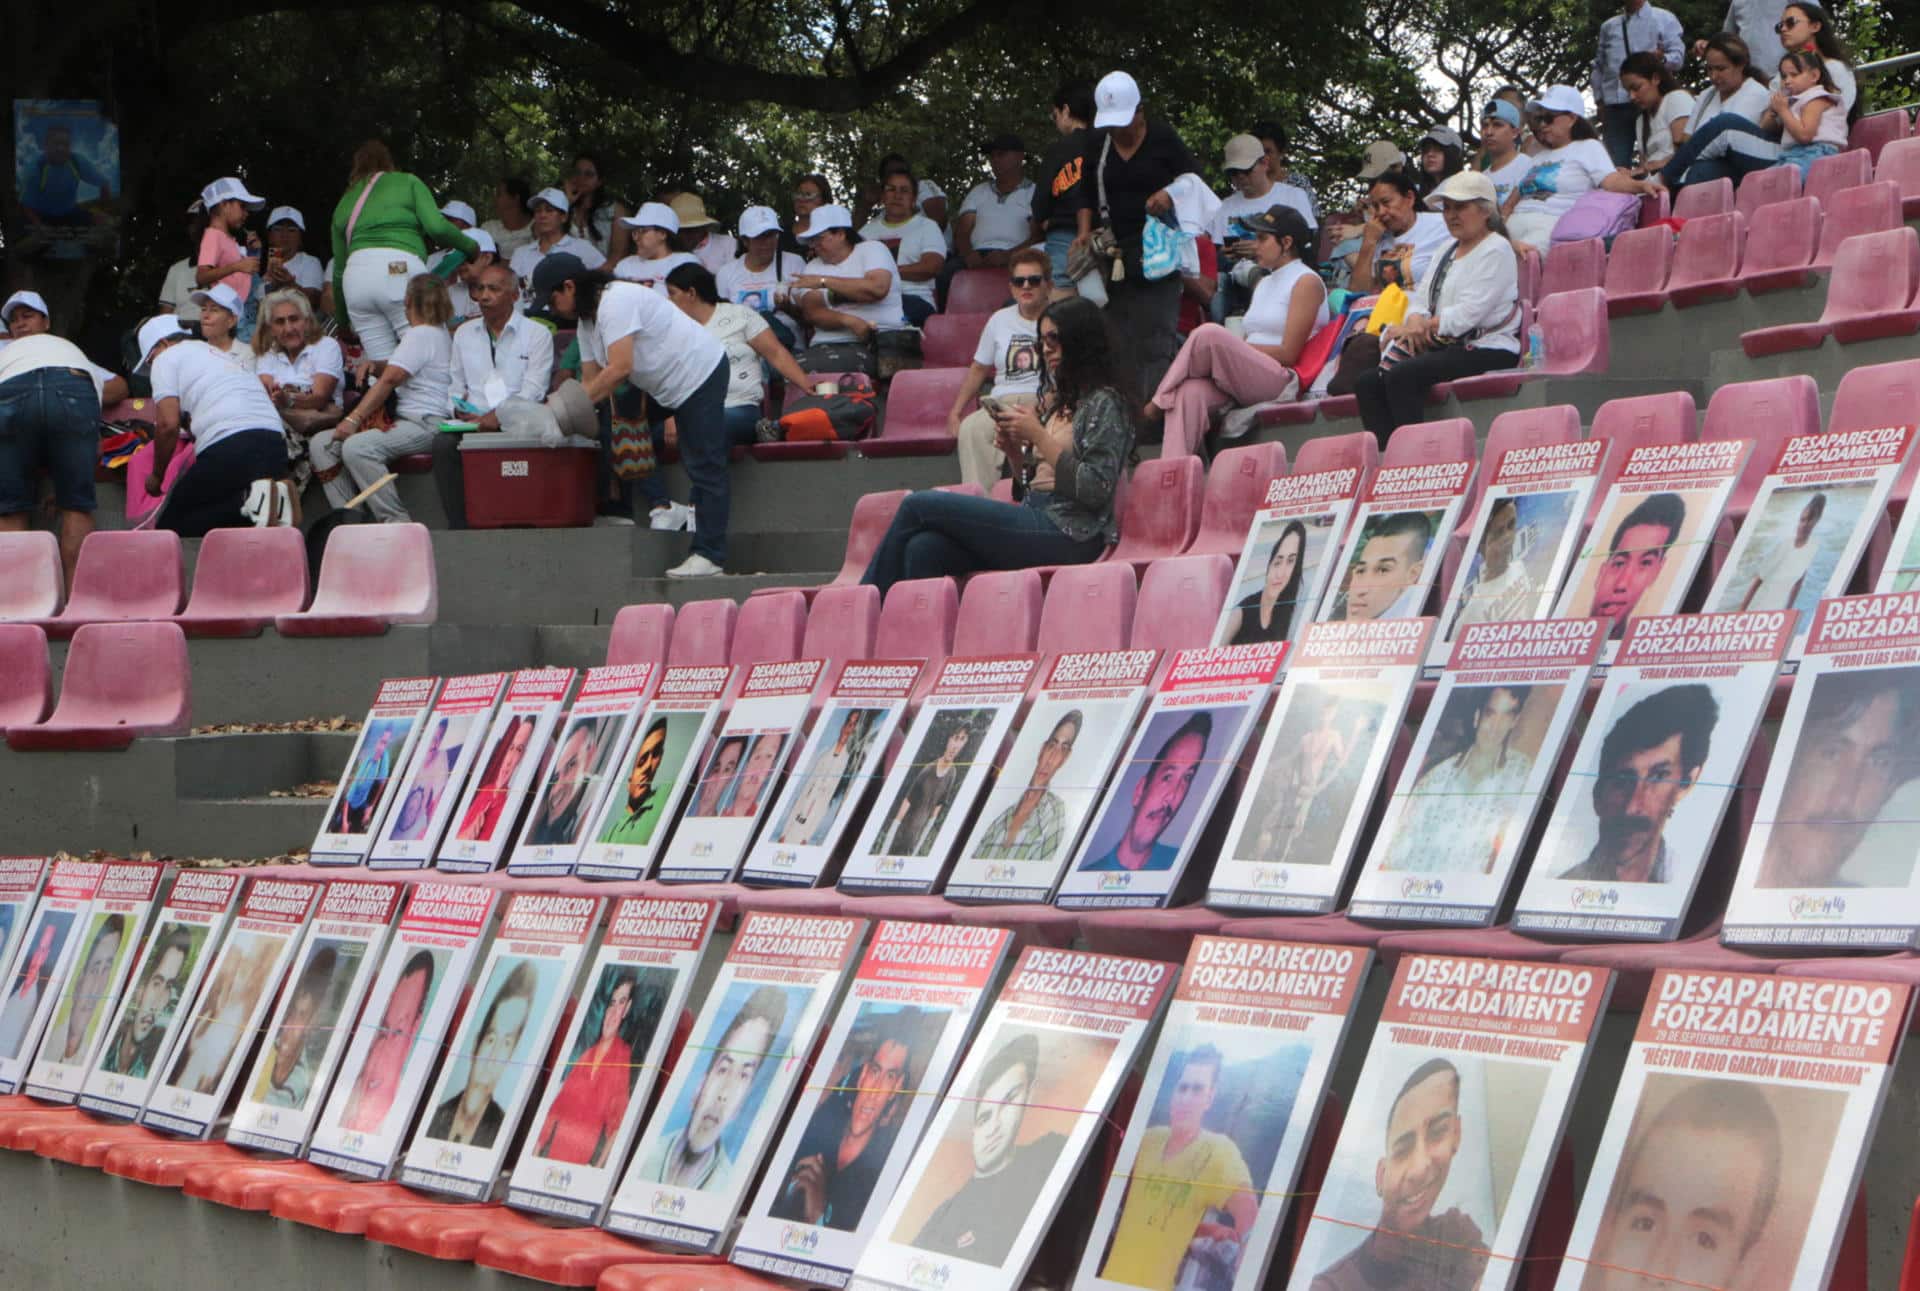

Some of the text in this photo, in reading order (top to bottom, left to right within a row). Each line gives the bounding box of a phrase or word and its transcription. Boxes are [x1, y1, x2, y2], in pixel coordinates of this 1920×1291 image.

[1786, 427, 1906, 452] DESAPARECIDA
[1503, 440, 1601, 463] DESAPARECIDO
[1631, 440, 1743, 461] DESAPARECIDO
[1779, 442, 1900, 466] FORZADAMENTE
[1378, 462, 1468, 481] DESAPARECIDO
[1499, 455, 1596, 477] FORZADAMENTE
[1624, 456, 1736, 475] FORZADAMENTE
[1270, 468, 1356, 491] DESAPARECIDO
[1372, 475, 1464, 495] FORZADAMENTE
[1265, 481, 1352, 503] FORZADAMENTE
[1309, 621, 1424, 641] DESAPARECIDO
[1465, 620, 1597, 643] DESAPARECIDO
[1634, 612, 1785, 637] DESAPARECIDO
[1178, 641, 1282, 665] DESAPARECIDO
[1302, 639, 1418, 657] FORZADAMENTE
[1458, 639, 1591, 660] FORZADAMENTE
[1627, 632, 1779, 655] FORZADAMENTE
[751, 660, 820, 678] DESAPARECIDO
[943, 659, 1034, 675] DESAPARECIDO
[1058, 649, 1156, 668] DESAPARECIDO
[1170, 657, 1277, 681] FORZADAMENTE
[844, 666, 918, 677] DESAPARECIDO
[938, 673, 1028, 686] FORZADAMENTE
[1051, 665, 1150, 682] FORZADAMENTE
[746, 674, 815, 691] FORZADAMENTE
[838, 677, 912, 689] FORZADAMENTE
[178, 872, 236, 891] DESAPARECIDO
[252, 880, 315, 898] DESAPARECIDO
[327, 882, 396, 901] DESAPARECIDO
[171, 886, 229, 905] FORZADAMENTE
[414, 884, 491, 904] DESAPARECIDO
[245, 895, 308, 915] FORZADAMENTE
[320, 898, 389, 917] FORZADAMENTE
[408, 902, 485, 921] FORZADAMENTE
[512, 895, 596, 915] DESAPARECIDO
[619, 899, 709, 920] DESAPARECIDO
[505, 912, 589, 933] FORZADAMENTE
[612, 918, 703, 940] FORZADAMENTE
[746, 915, 854, 938] DESAPARECIDO
[879, 921, 1000, 946] DESAPARECIDO
[737, 936, 846, 958] FORZADAMENTE
[870, 943, 992, 969] FORZADAMENTE
[1196, 940, 1354, 975] DESAPARECIDO
[1024, 950, 1165, 984] DESAPARECIDO
[1407, 957, 1594, 998] DESAPARECIDO
[1013, 971, 1155, 1006] FORZADAMENTE
[1189, 965, 1346, 999] FORZADAMENTE
[1397, 983, 1585, 1024] FORZADAMENTE
[1659, 974, 1892, 1016] DESAPARECIDO
[1650, 1003, 1885, 1046] FORZADAMENTE
[1669, 1033, 1680, 1042] DE
[1680, 1034, 1729, 1046] SEPTIEMBRE
[1732, 1037, 1744, 1047] DE
[1642, 1045, 1871, 1086] "HÉCTOR FABIO GARZÓN VALDERRAMA"
